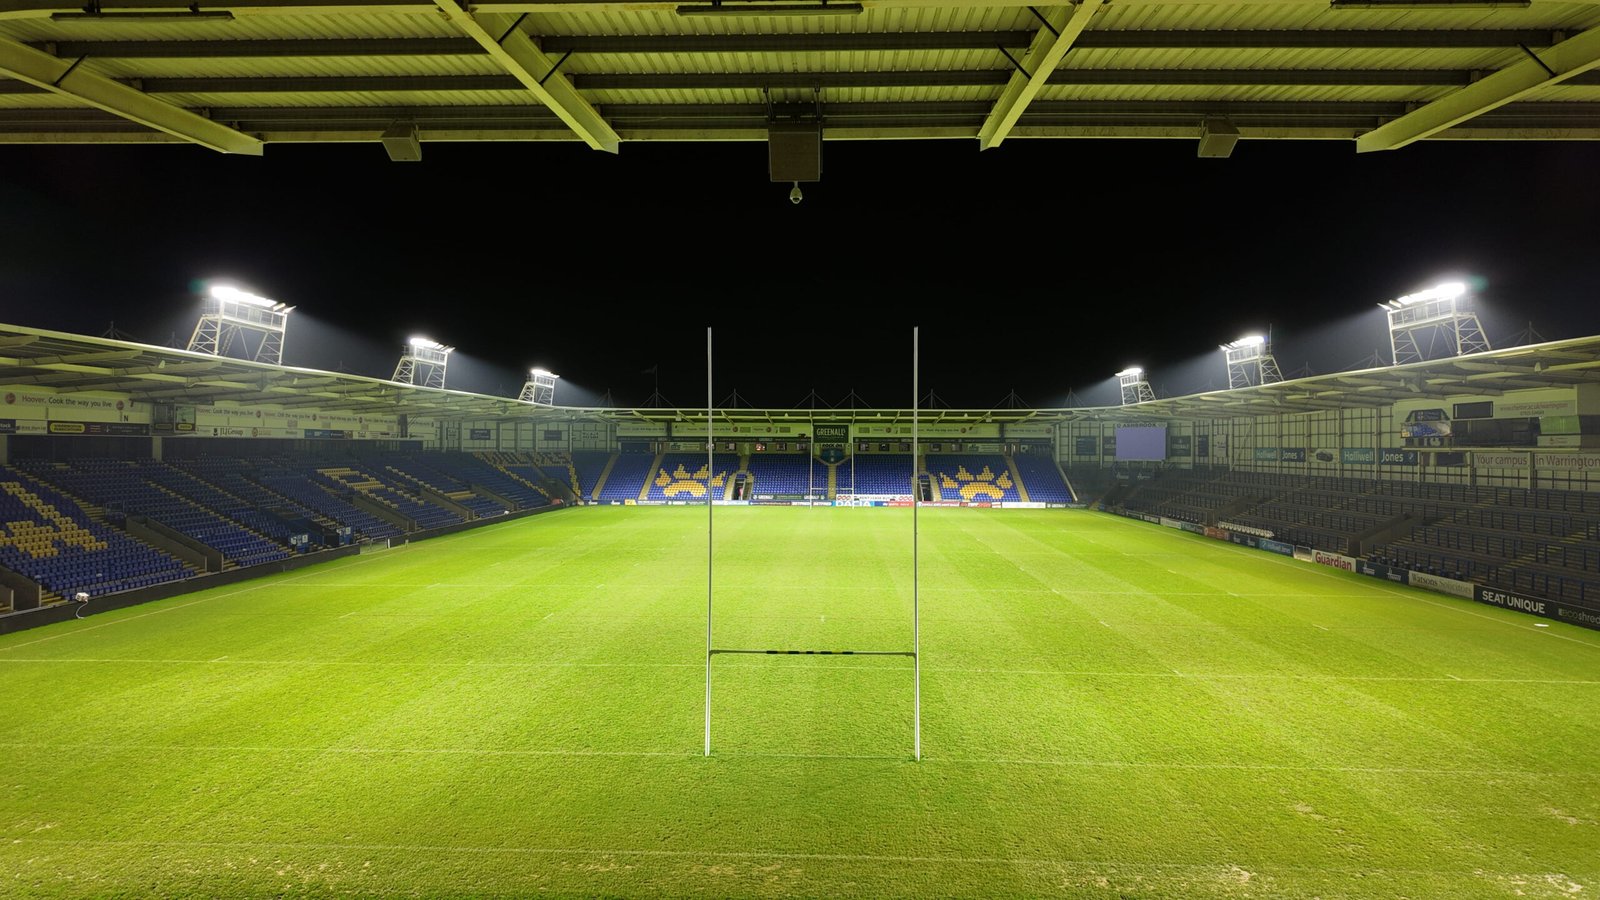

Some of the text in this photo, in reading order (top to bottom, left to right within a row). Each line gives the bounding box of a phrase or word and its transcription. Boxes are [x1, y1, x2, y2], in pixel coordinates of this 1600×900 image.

[48, 397, 63, 405] Cook
[65, 397, 76, 405] the
[78, 399, 89, 408] way
[90, 400, 101, 408] you
[1381, 451, 1404, 463] Jones
[1475, 454, 1600, 469] Your campus in Warrington
[1315, 552, 1352, 571] Guardian
[1482, 590, 1546, 614] SEAT UNIQUE
